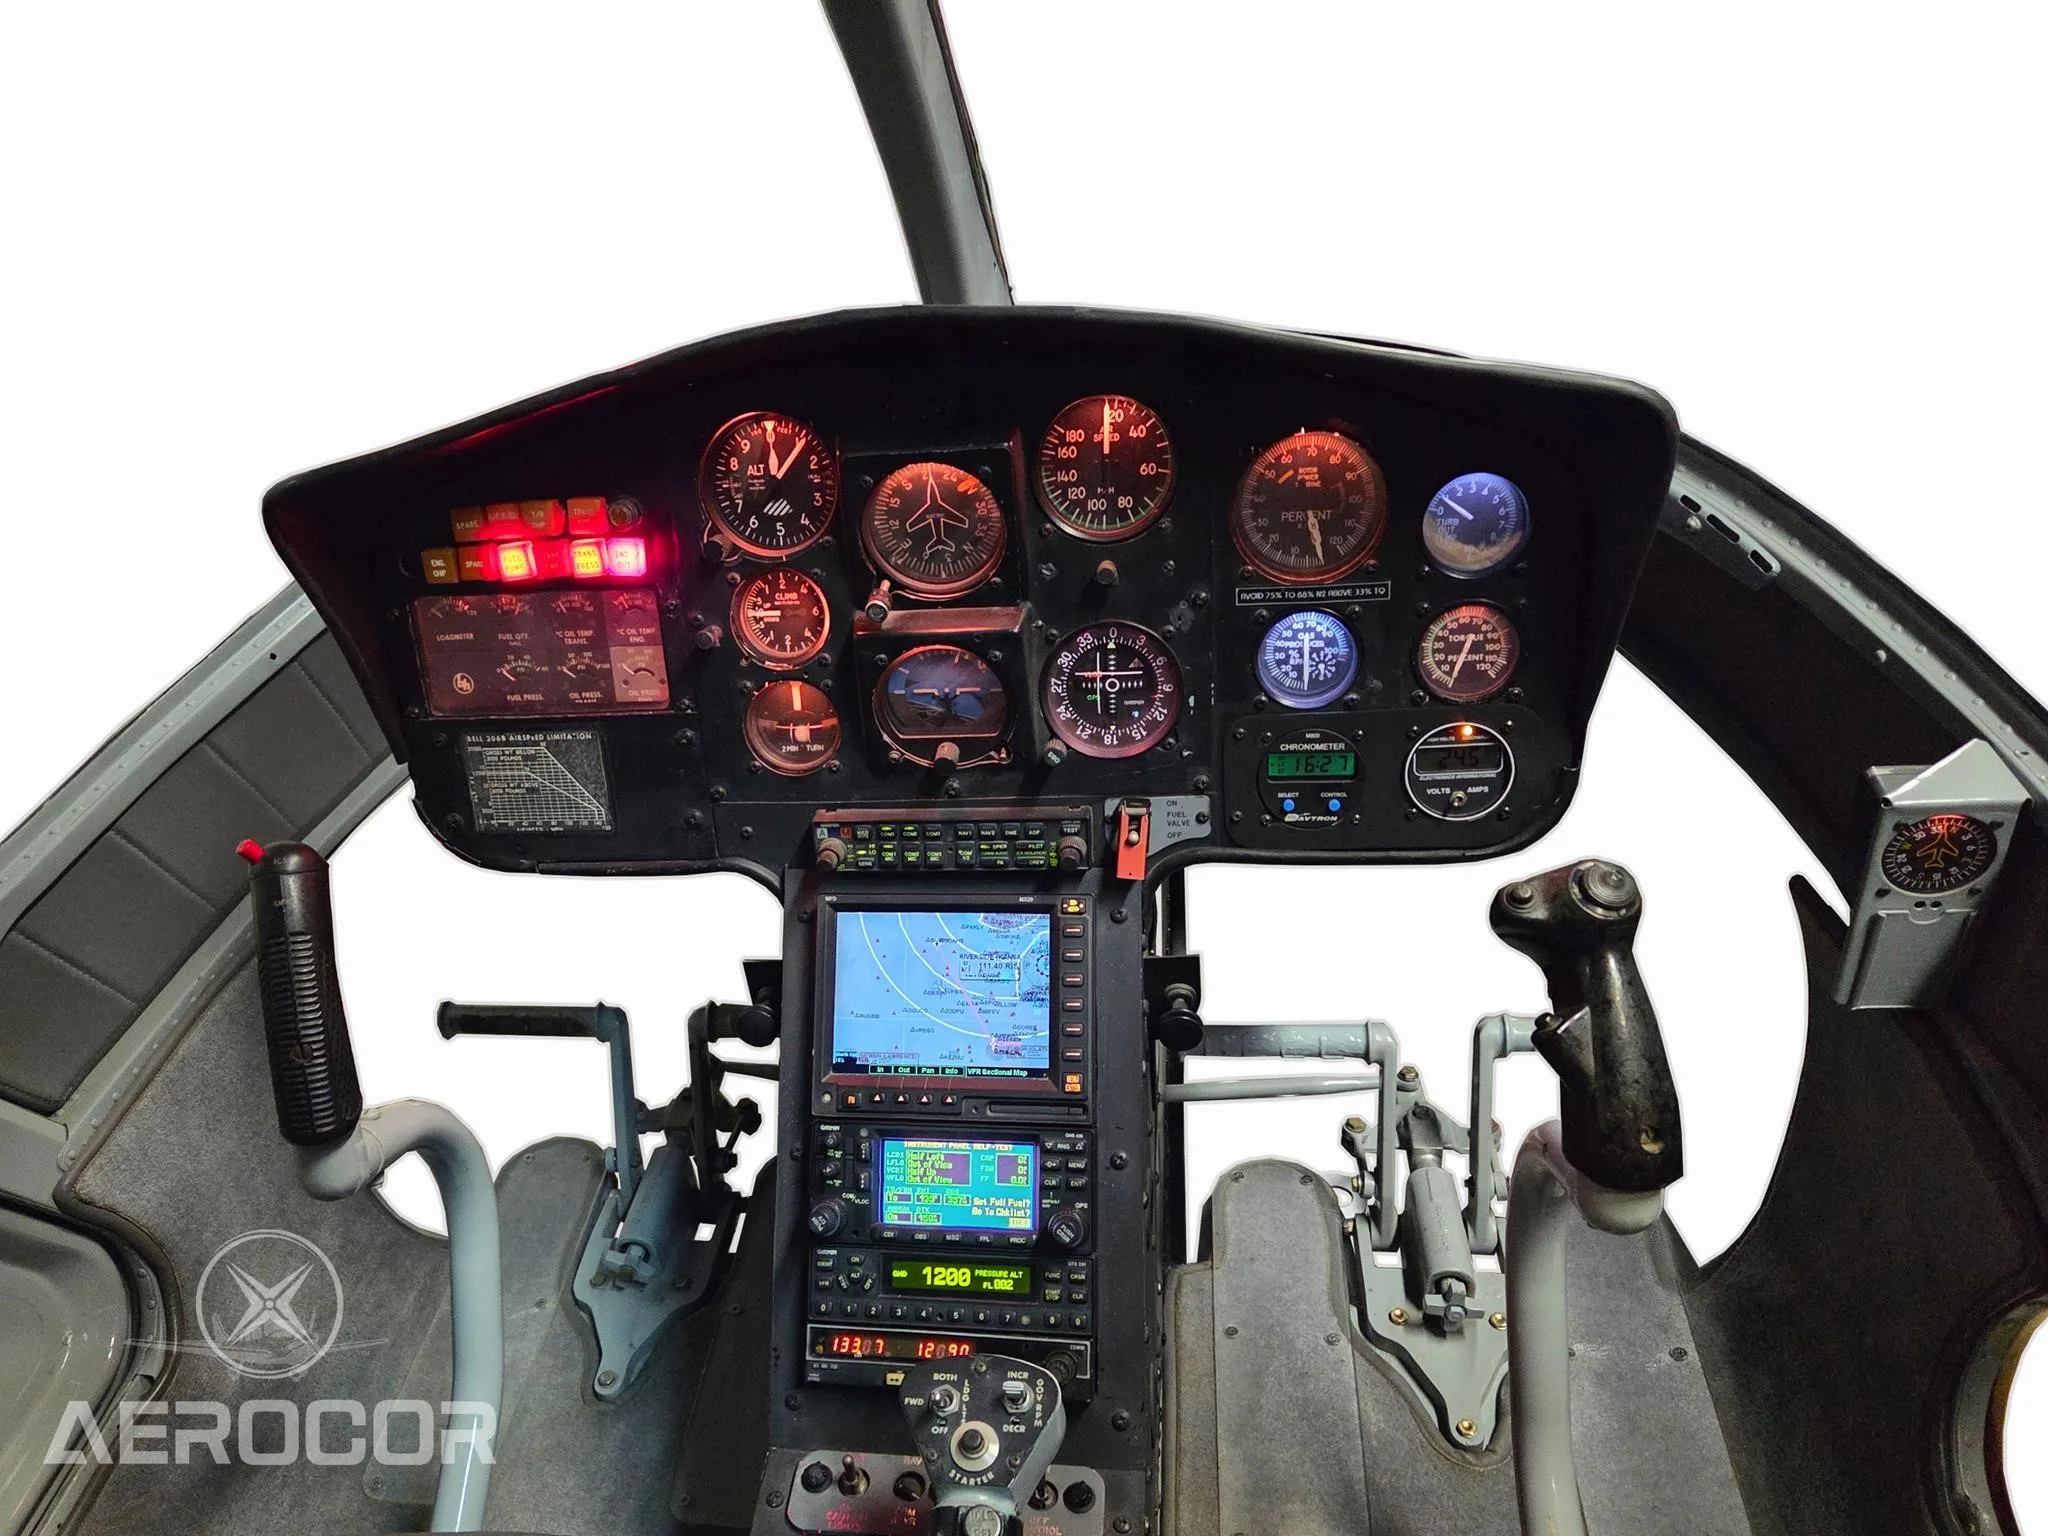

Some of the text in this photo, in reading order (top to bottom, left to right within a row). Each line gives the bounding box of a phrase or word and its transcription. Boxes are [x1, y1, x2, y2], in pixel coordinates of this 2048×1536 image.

[1109, 409, 1124, 422] 20
[1066, 430, 1085, 442] 180
[1093, 433, 1120, 442] SPED
[1129, 425, 1146, 438] 40
[741, 439, 750, 453] 9
[1307, 447, 1318, 456] 70
[1058, 447, 1077, 458] 160
[730, 457, 738, 470] 8
[810, 455, 818, 469] 2
[1281, 456, 1293, 464] 60
[1330, 456, 1341, 464] 80
[747, 464, 764, 476] ALT
[1140, 463, 1156, 475] 60
[1265, 470, 1276, 479] 50
[1057, 470, 1077, 482] 140
[1346, 472, 1357, 480] 90
[1068, 487, 1085, 499] 120
[1088, 499, 1106, 510] 100
[1118, 497, 1133, 508] 80
[456, 520, 480, 529] SPARE
[750, 515, 758, 528] 6
[801, 513, 810, 525] 4
[777, 523, 785, 536] 5
[1268, 534, 1279, 543] 20
[1329, 536, 1343, 545] 120
[775, 592, 798, 600] CLIMB
[1240, 592, 1264, 600] AVOID
[1265, 591, 1282, 599] 75%
[1285, 591, 1296, 599] TO
[1328, 589, 1352, 597] ABOVE
[1354, 588, 1371, 596] 33%
[1077, 633, 1093, 647] 33
[1057, 651, 1072, 667] 30
[1051, 678, 1062, 693] 27
[1056, 705, 1072, 720] 24
[1153, 707, 1168, 721] 12
[1280, 743, 1345, 751] CHRONOMETER
[1295, 755, 1348, 773] 16:27
[922, 1267, 971, 1287] 1200
[933, 1373, 957, 1381] BOTH
[1007, 1371, 1029, 1379] INCR
[962, 1379, 970, 1401] LDG
[1034, 1379, 1044, 1427] GOV RPM
[1003, 1425, 1026, 1433] DECR
[949, 1469, 995, 1486] STARTER
